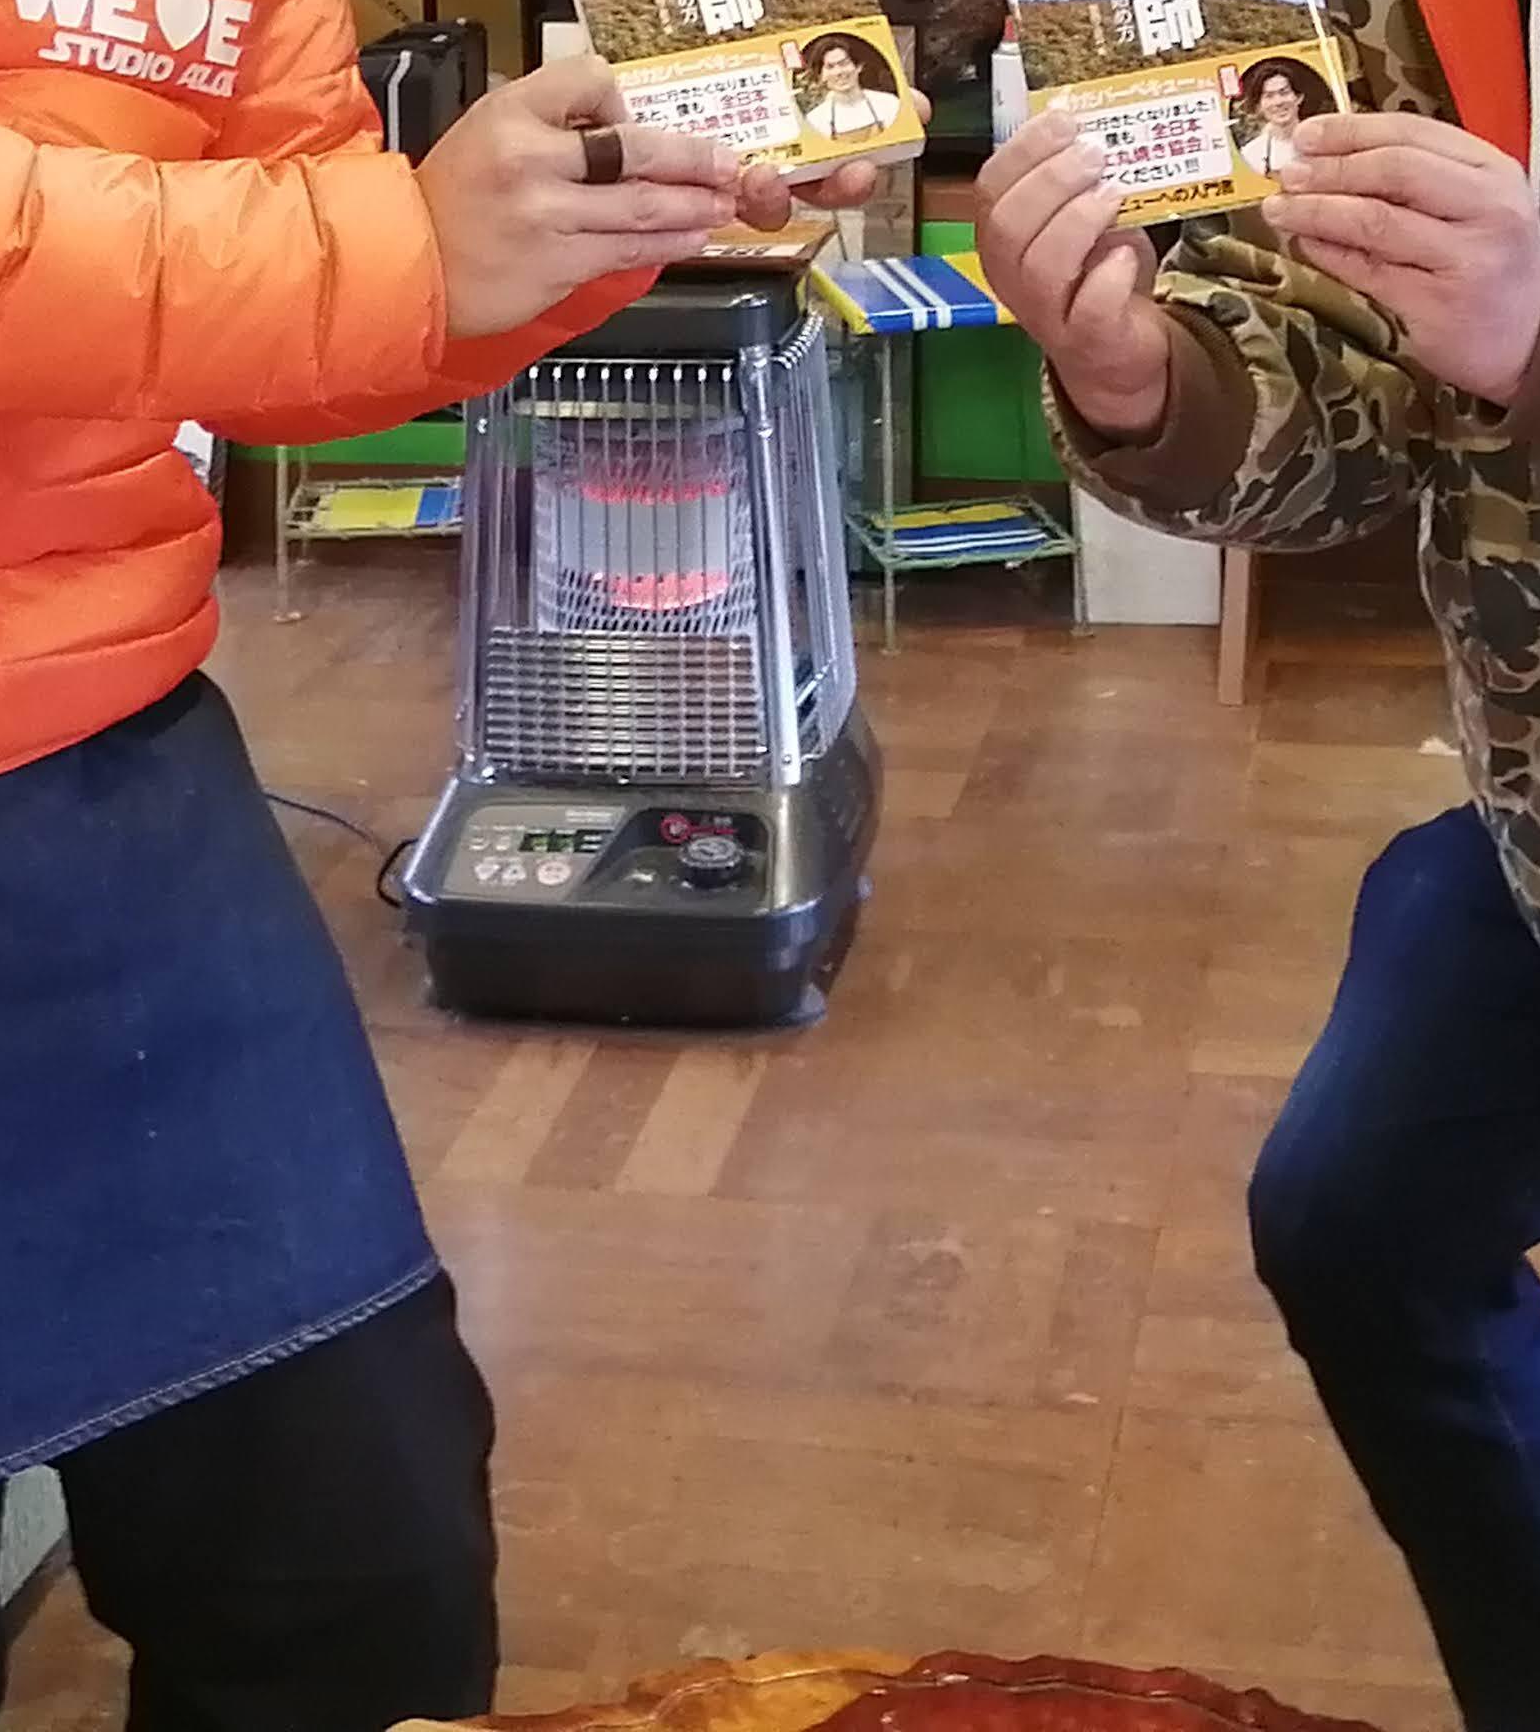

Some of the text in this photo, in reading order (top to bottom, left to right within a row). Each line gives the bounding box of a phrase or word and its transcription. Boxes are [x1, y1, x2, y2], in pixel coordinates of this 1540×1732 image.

[37, 29, 176, 83] STUDIO
[1075, 97, 1218, 134] に行きたくなりました!
